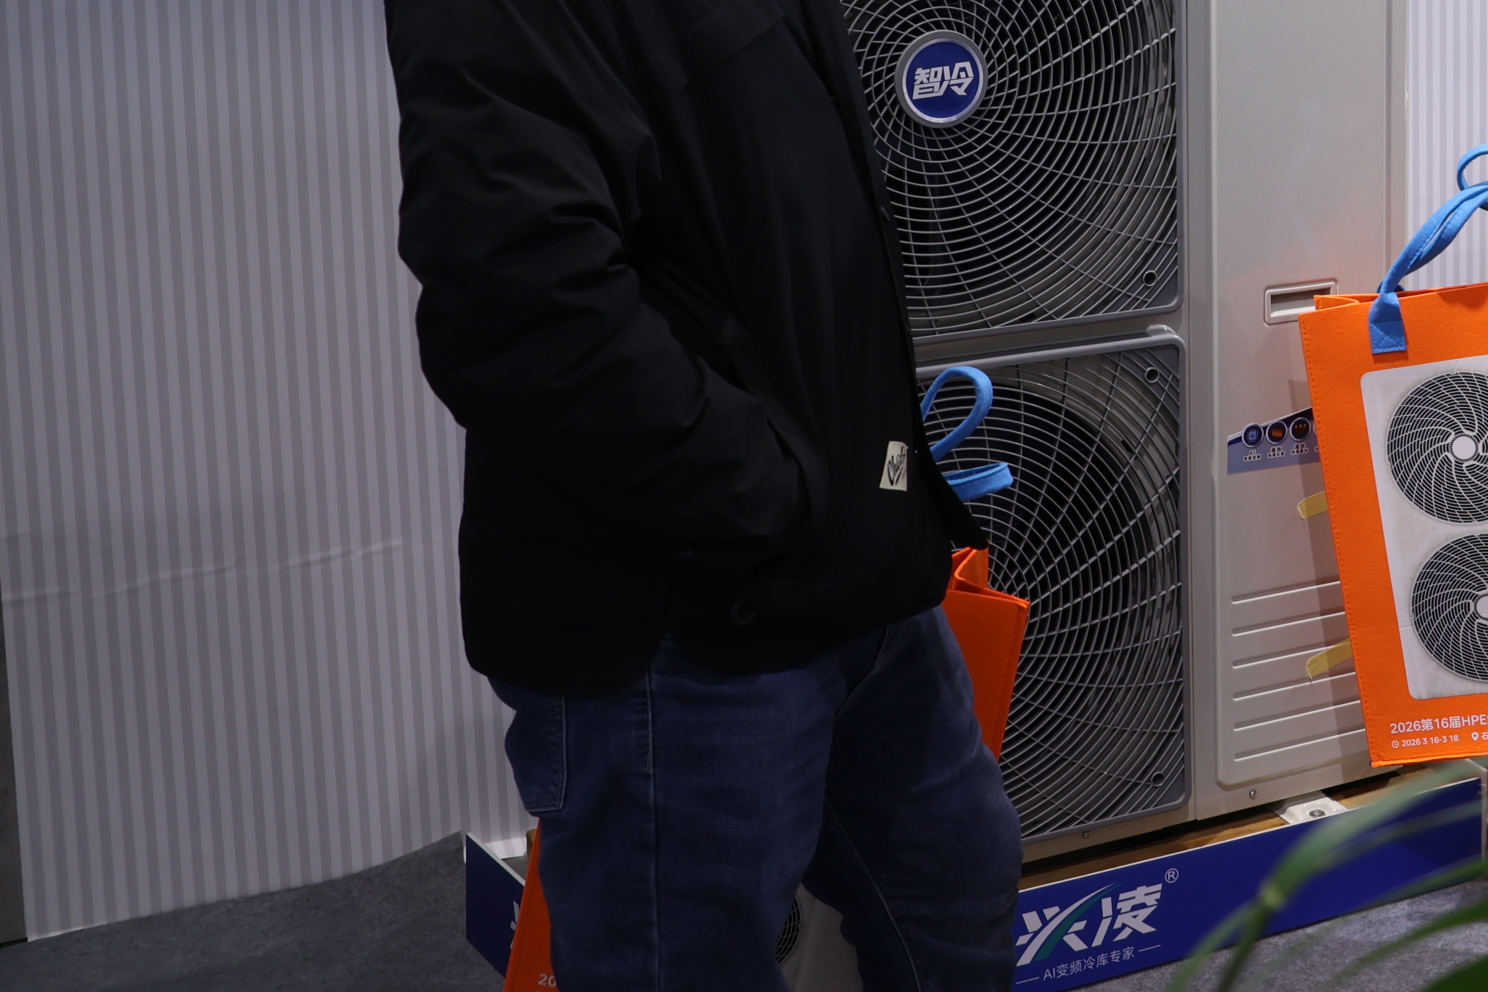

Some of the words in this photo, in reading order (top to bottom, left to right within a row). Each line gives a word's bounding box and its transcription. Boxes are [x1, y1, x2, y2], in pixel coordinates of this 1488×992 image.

[912, 61, 974, 100] 智冷
[1401, 738, 1421, 747] 2026
[1422, 737, 1428, 745] 3
[1449, 734, 1459, 742] 18
[1043, 946, 1135, 981] AI变频冷库专家
